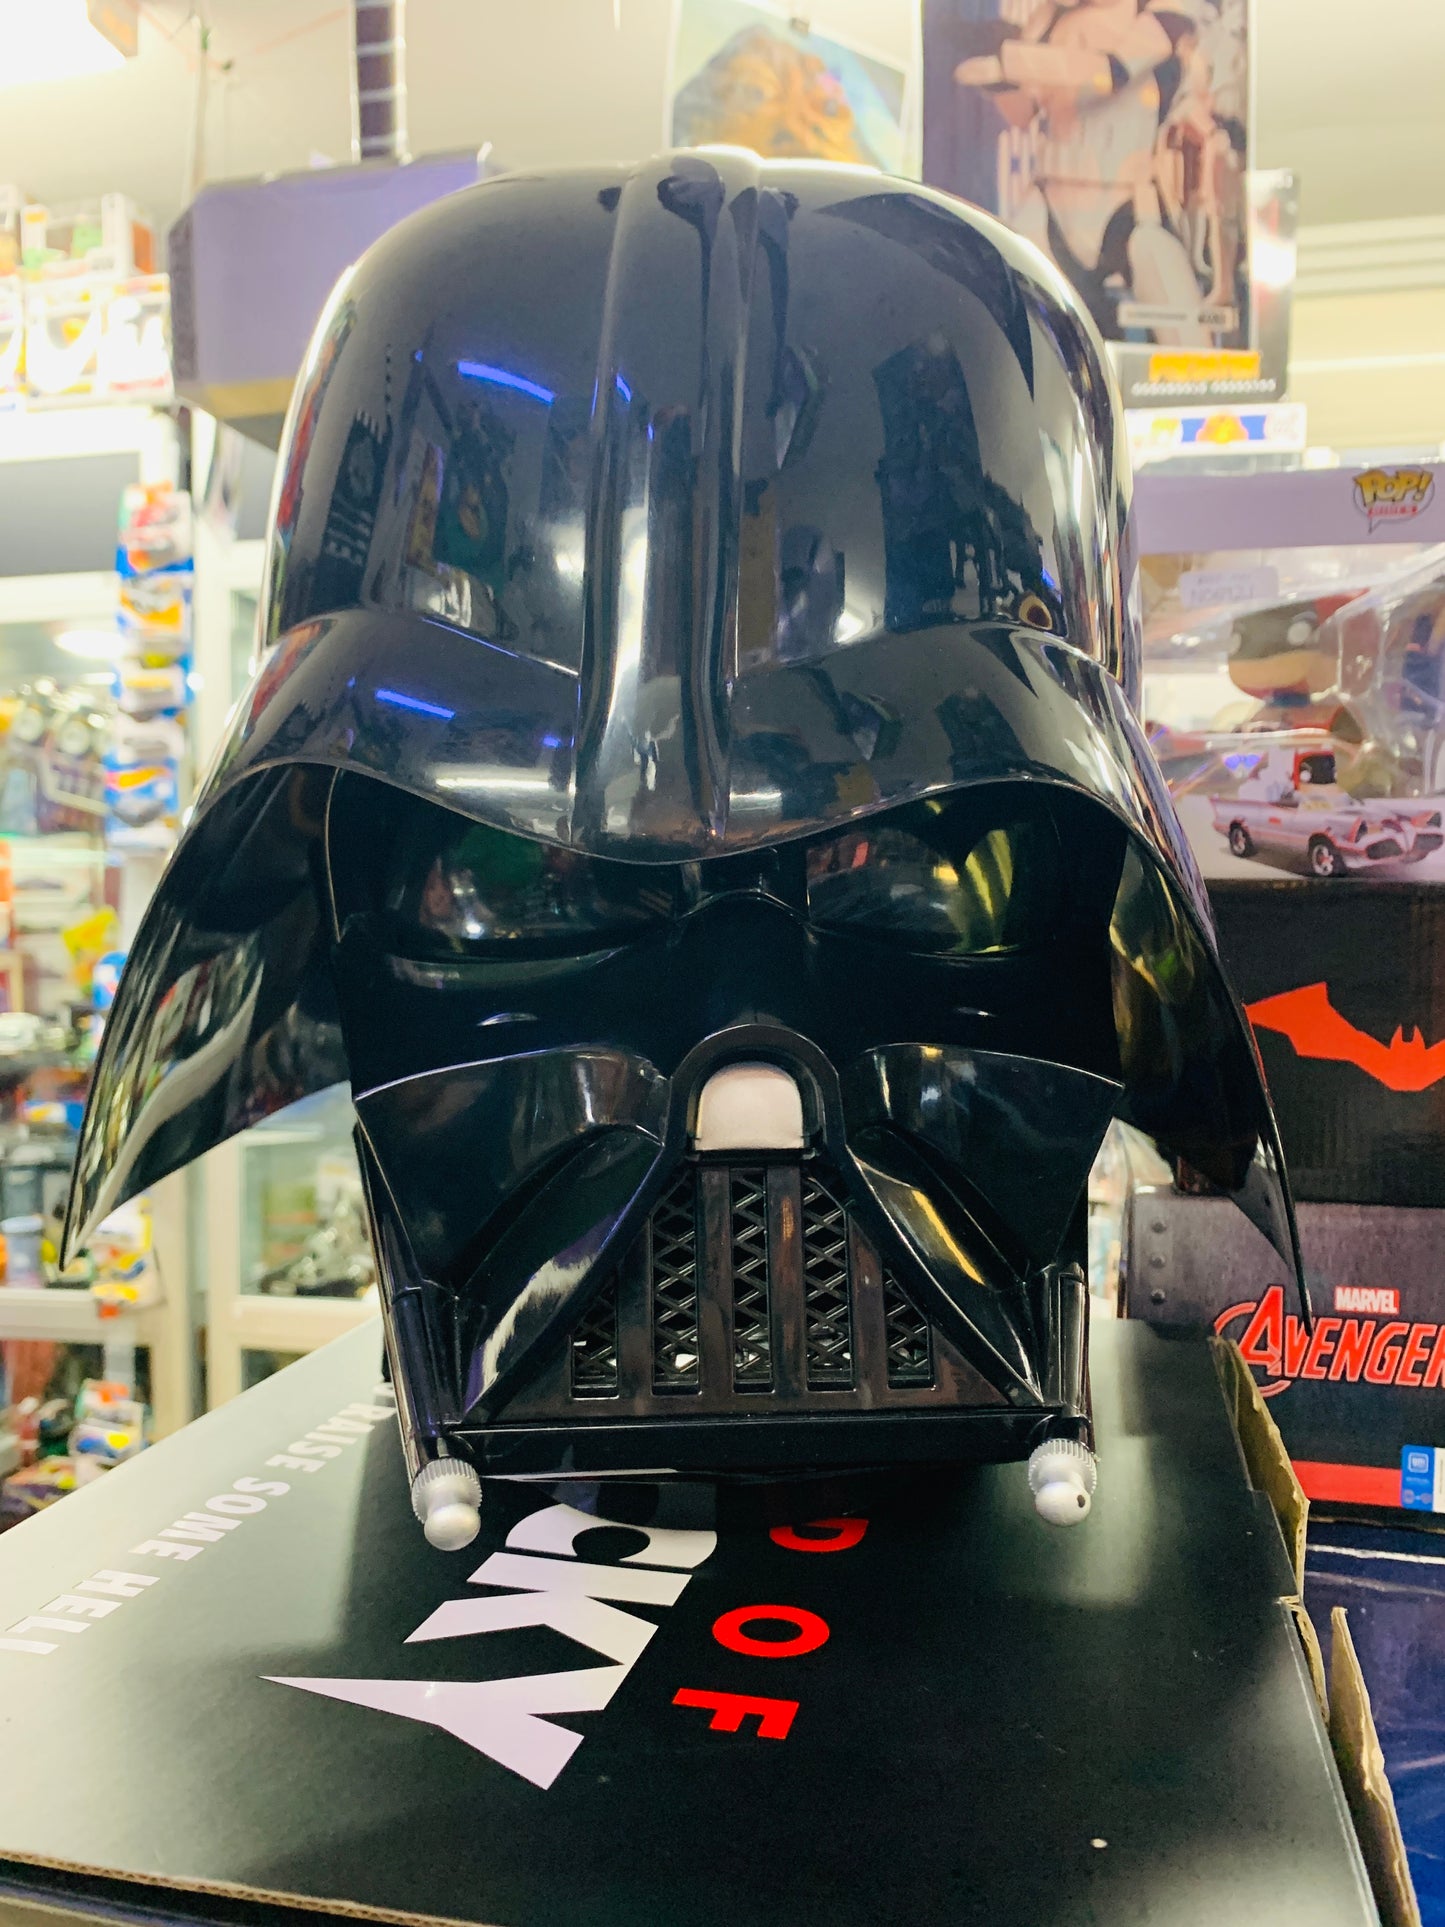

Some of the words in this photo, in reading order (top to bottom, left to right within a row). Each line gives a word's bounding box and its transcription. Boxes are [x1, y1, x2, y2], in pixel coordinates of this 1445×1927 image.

[1335, 1286, 1399, 1314] MARVEL
[265, 1402, 398, 1473] RAISE
[128, 1476, 291, 1561] SOME
[672, 1604, 829, 1739] OF
